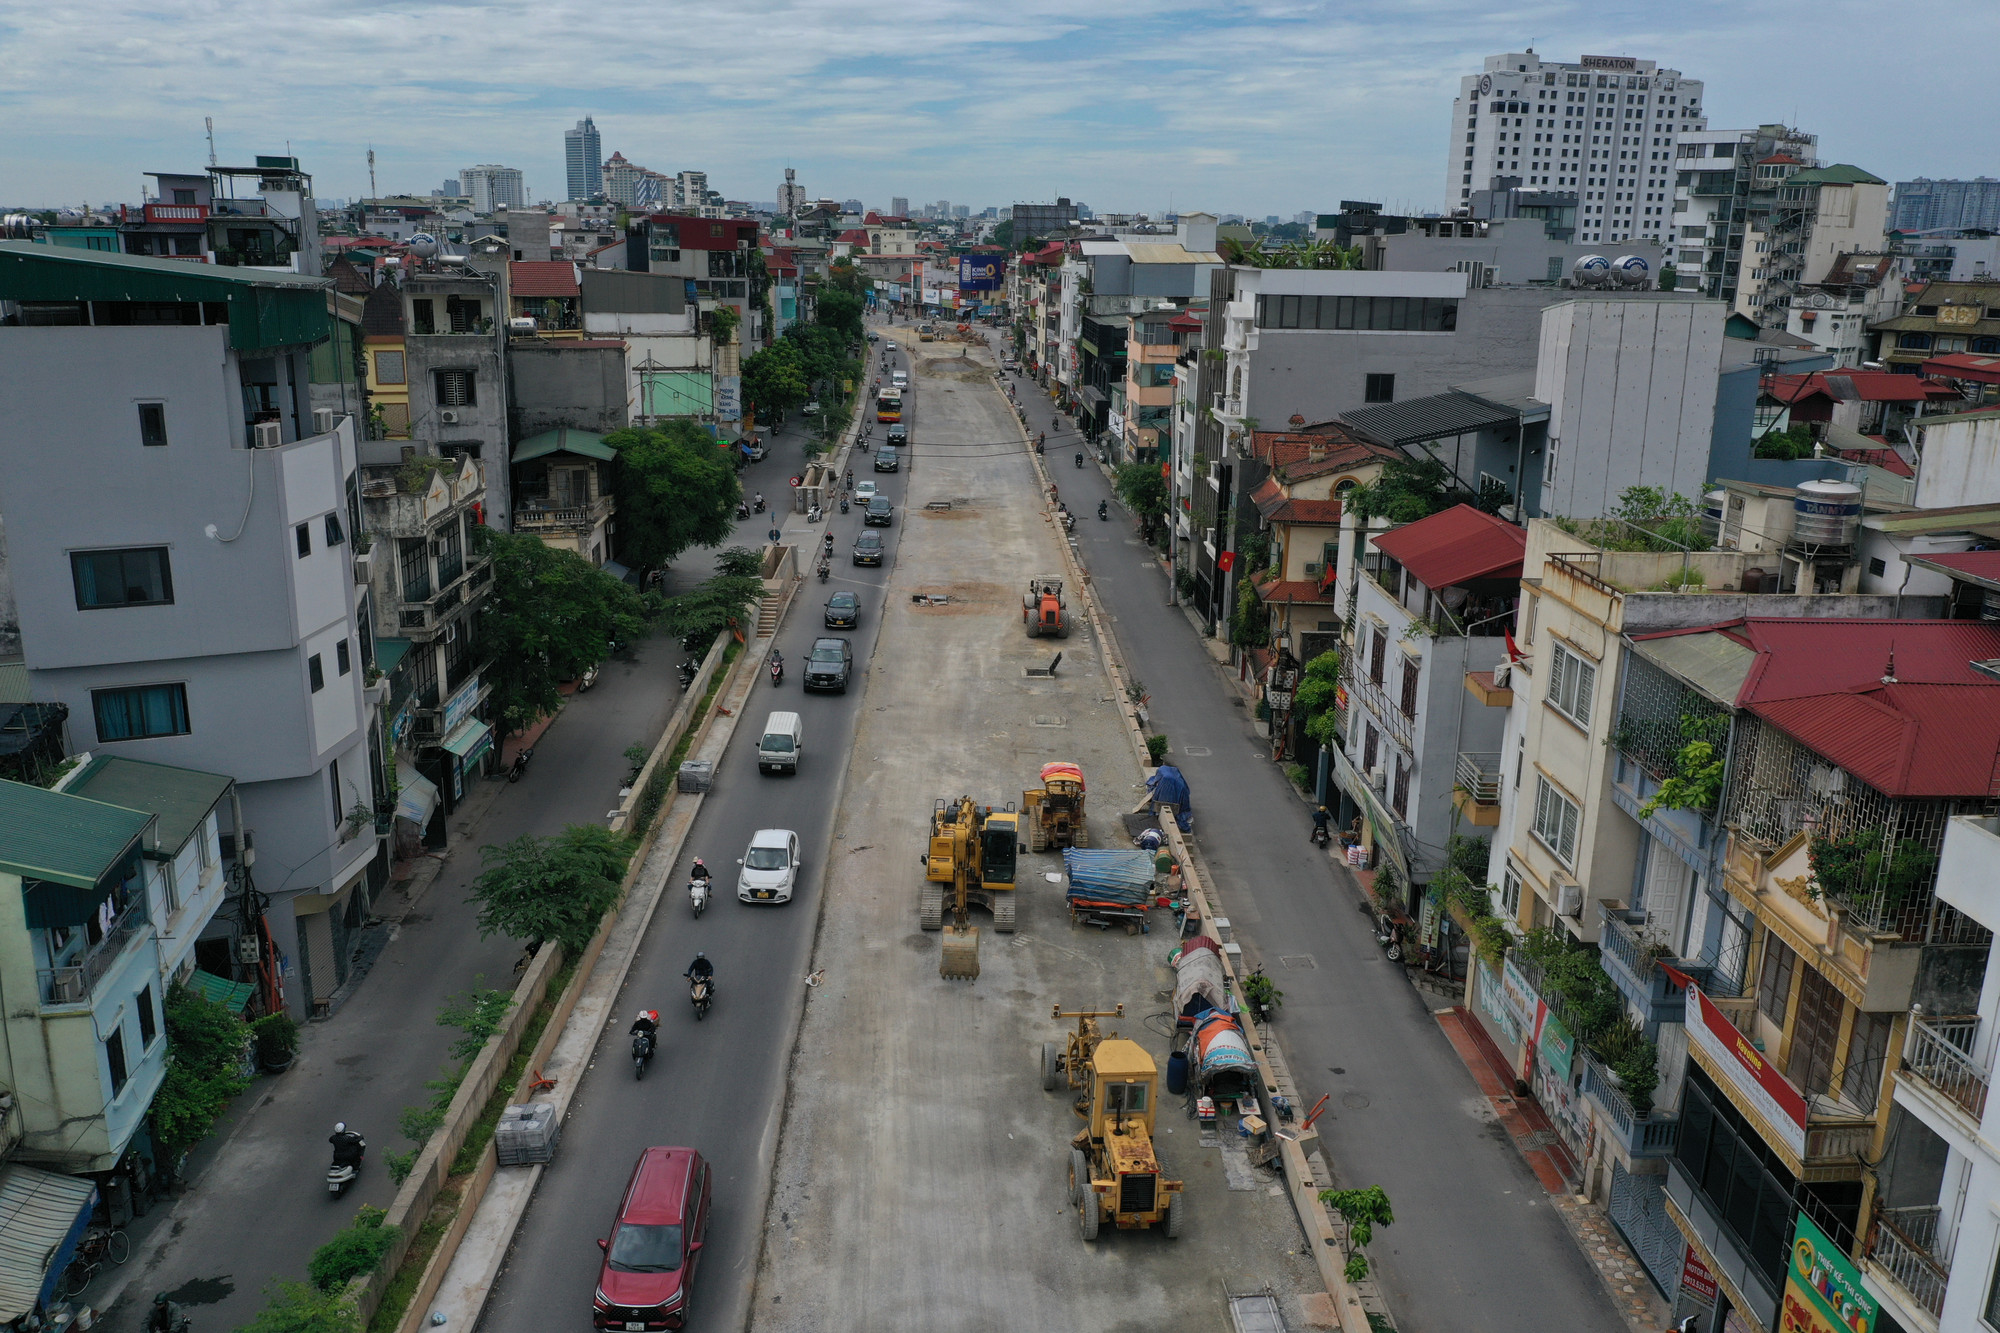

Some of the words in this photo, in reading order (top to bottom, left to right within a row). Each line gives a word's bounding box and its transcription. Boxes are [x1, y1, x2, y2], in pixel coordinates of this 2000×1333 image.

[1582, 58, 1634, 69] SHERATON
[1736, 1036, 1762, 1070] Havoline
[1686, 1262, 1704, 1278] MOTOR
